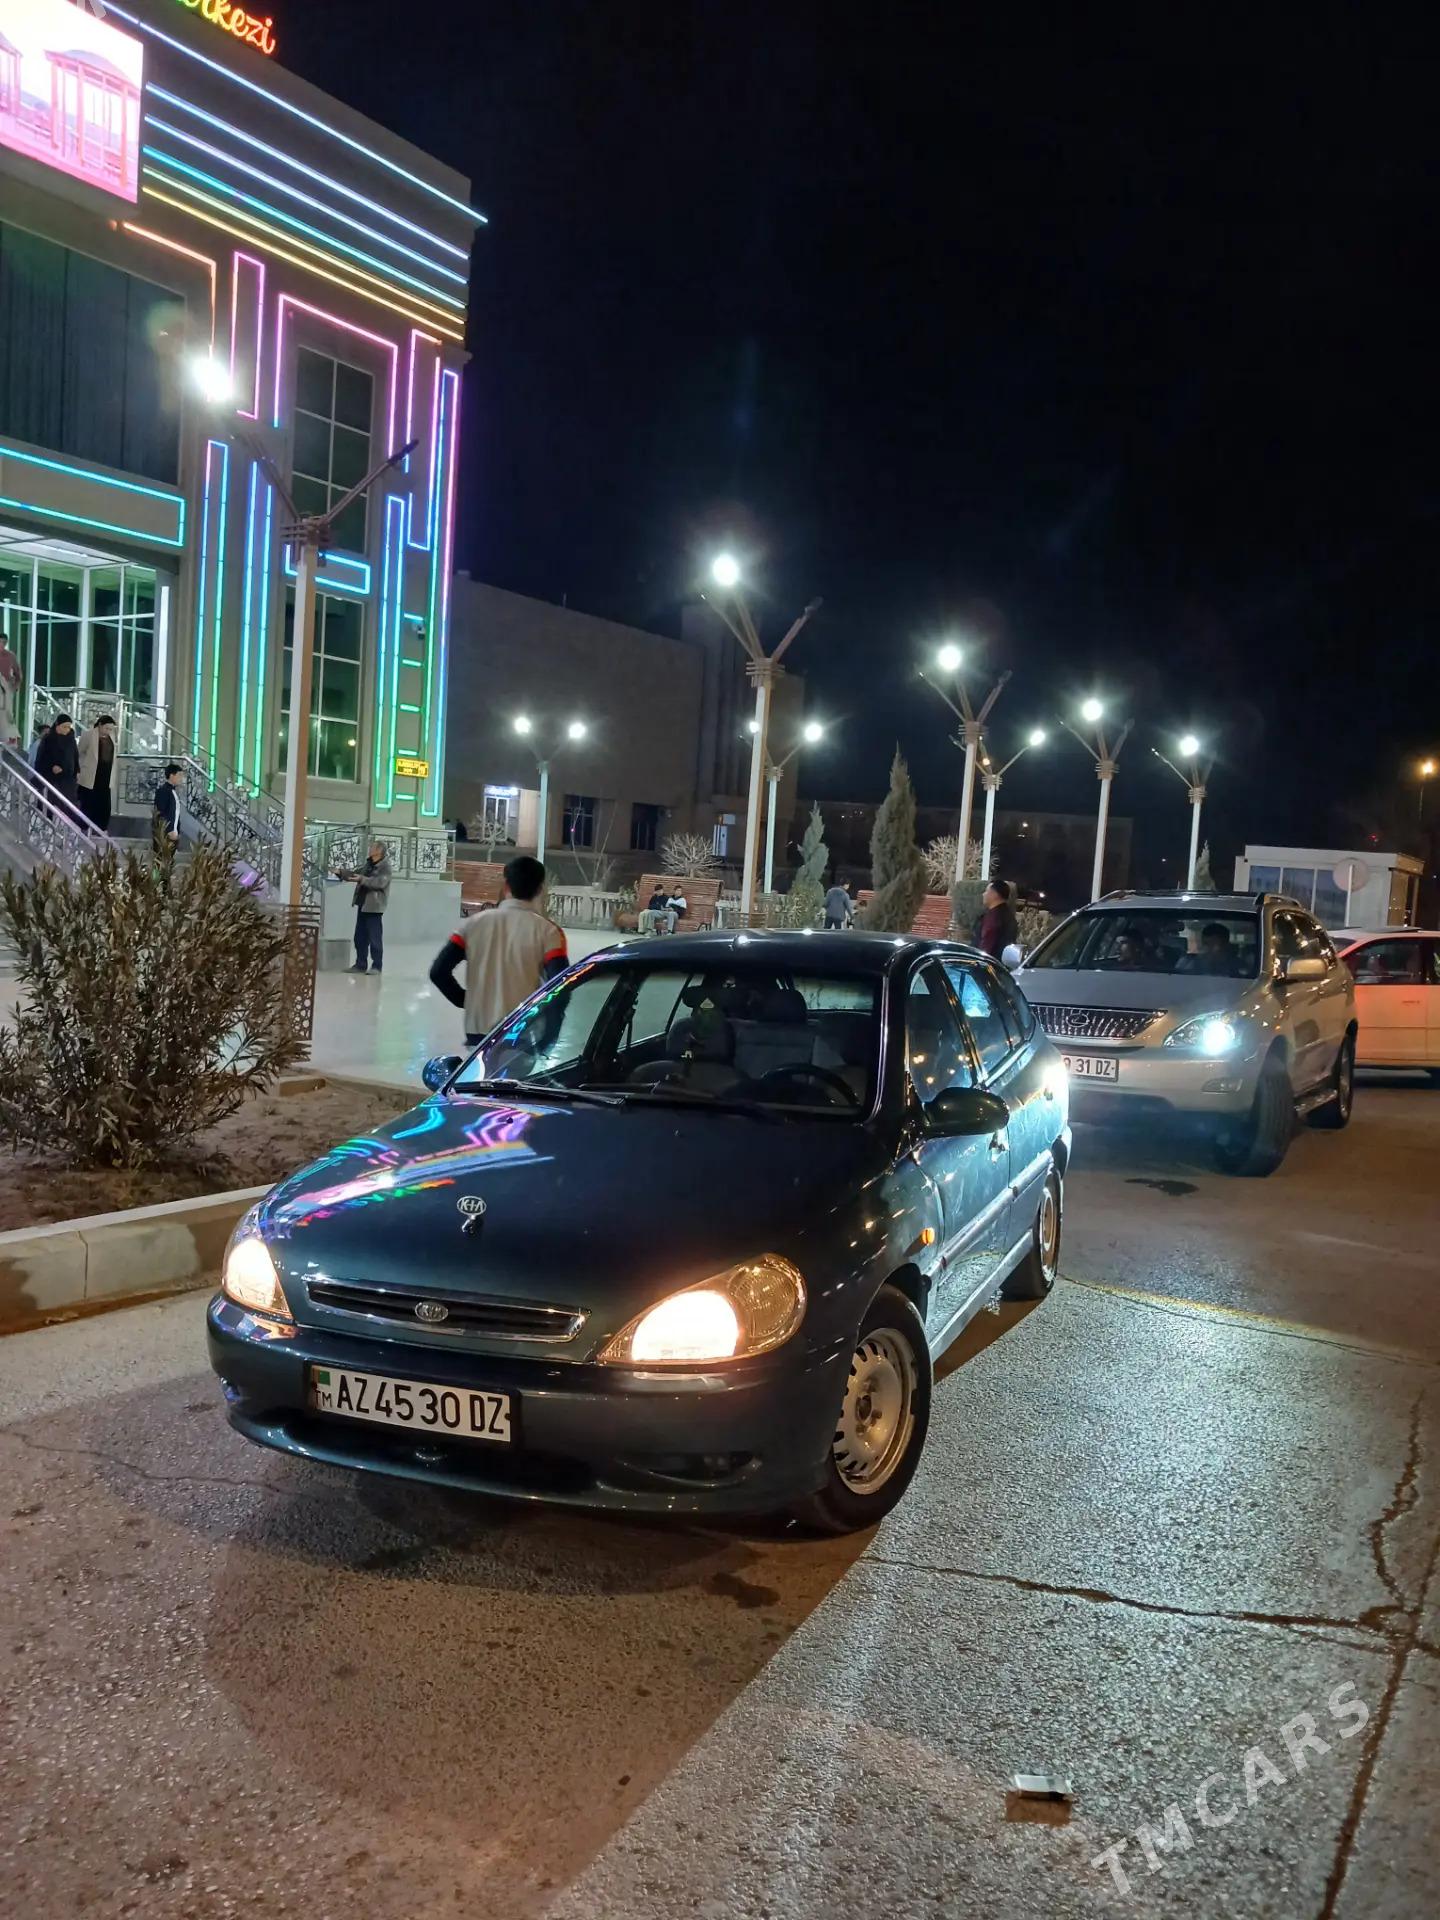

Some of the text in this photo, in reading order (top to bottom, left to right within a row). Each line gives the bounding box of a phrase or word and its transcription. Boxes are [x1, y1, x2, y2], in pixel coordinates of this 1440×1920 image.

[1095, 1059, 1111, 1075] DZ
[458, 1198, 485, 1213] KIA
[315, 1390, 333, 1408] TM
[469, 1394, 505, 1434] DZ
